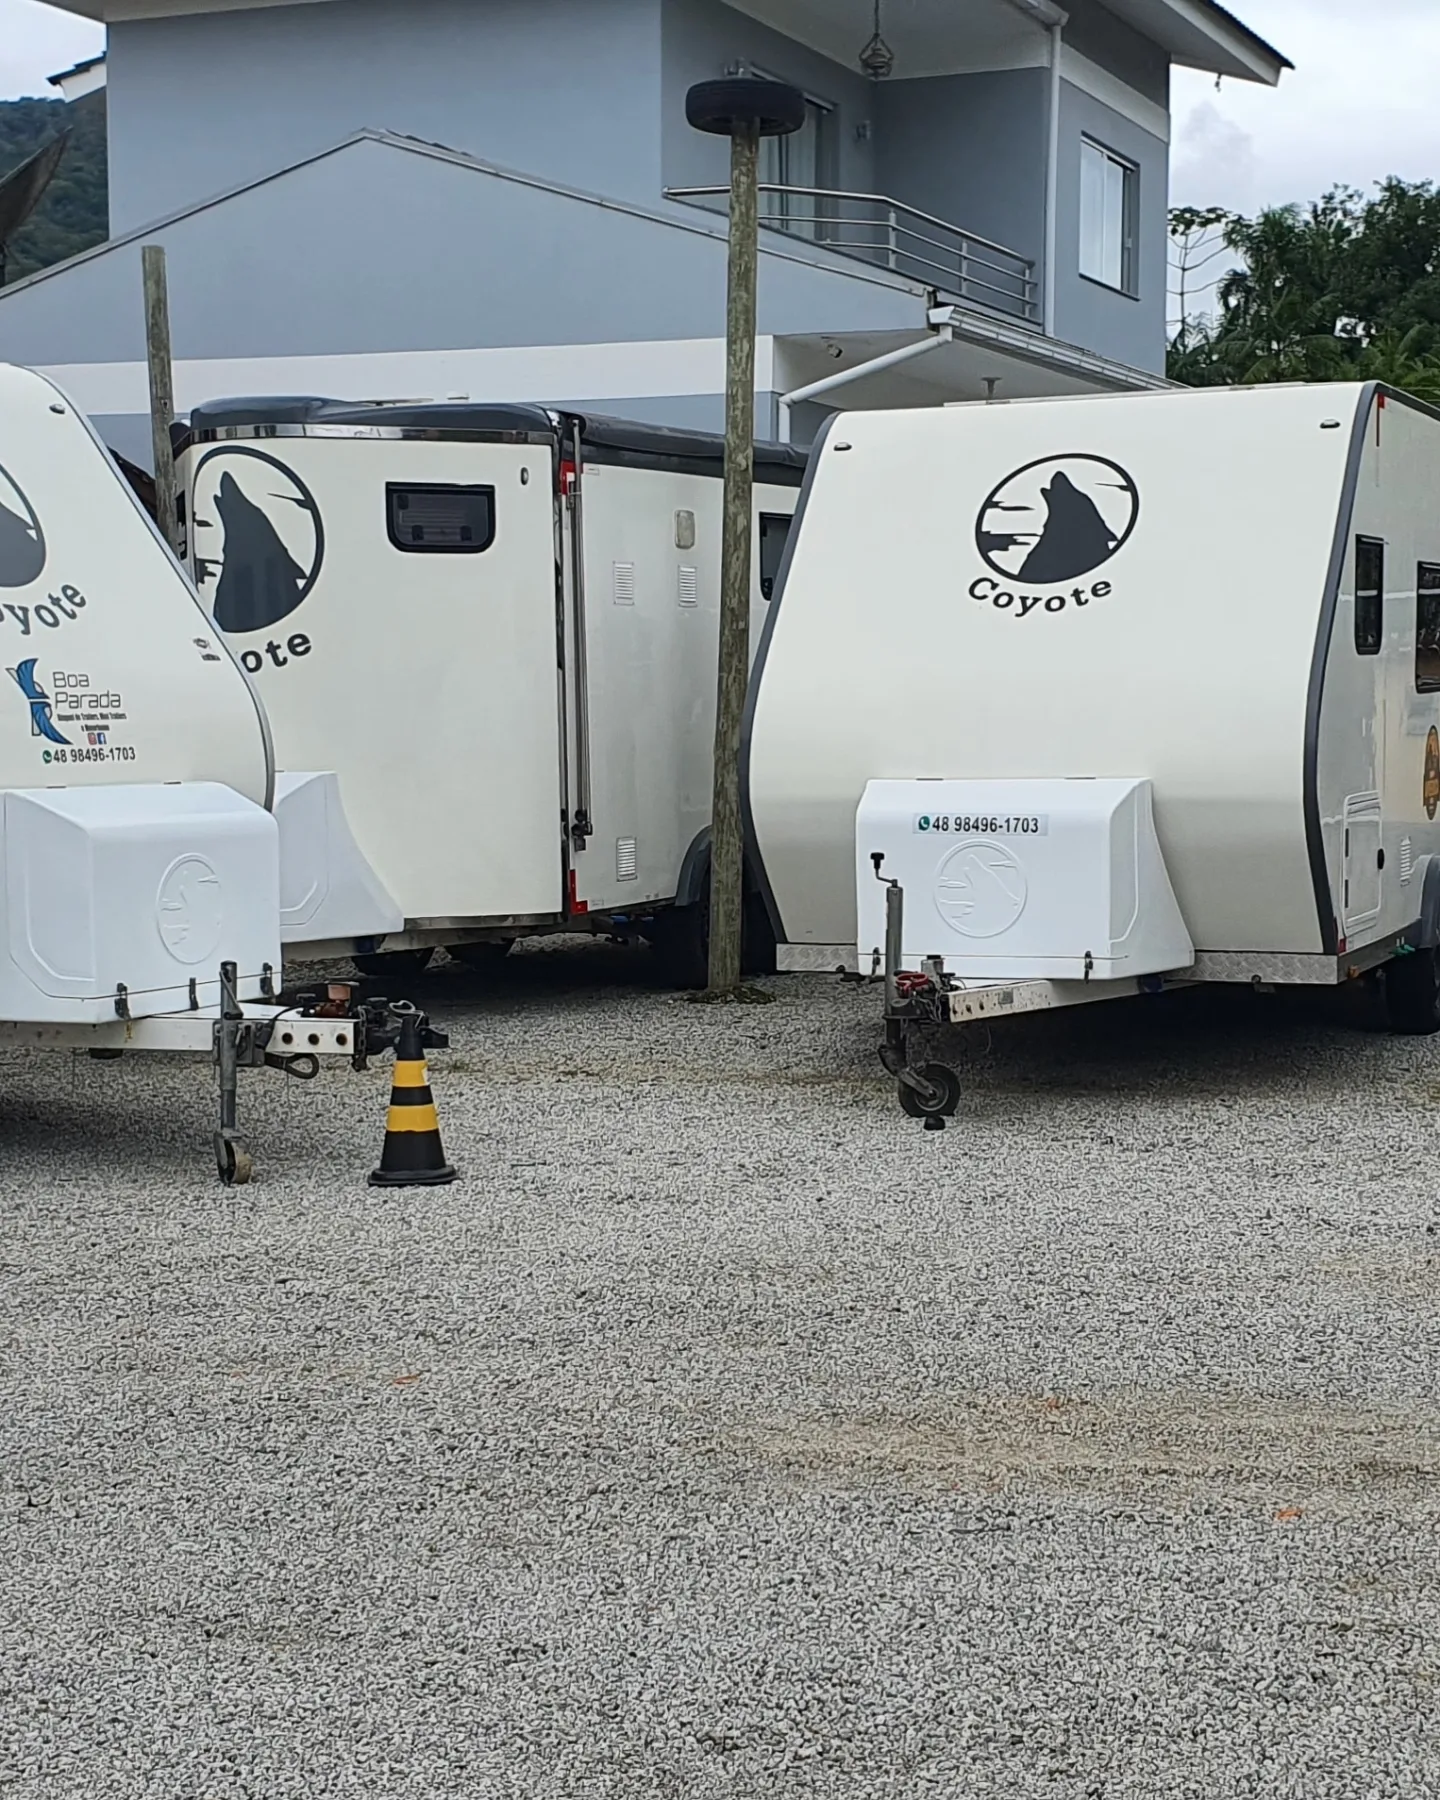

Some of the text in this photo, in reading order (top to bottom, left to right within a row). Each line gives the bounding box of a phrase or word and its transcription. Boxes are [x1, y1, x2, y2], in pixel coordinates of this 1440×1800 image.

[968, 577, 1112, 618] Coyote
[0, 584, 87, 636] yote
[236, 633, 312, 674] ote
[52, 671, 90, 689] Boa
[55, 689, 121, 709] Parada
[53, 746, 136, 764] 48 98496-1703
[932, 816, 1039, 833] 48 98496-1703
